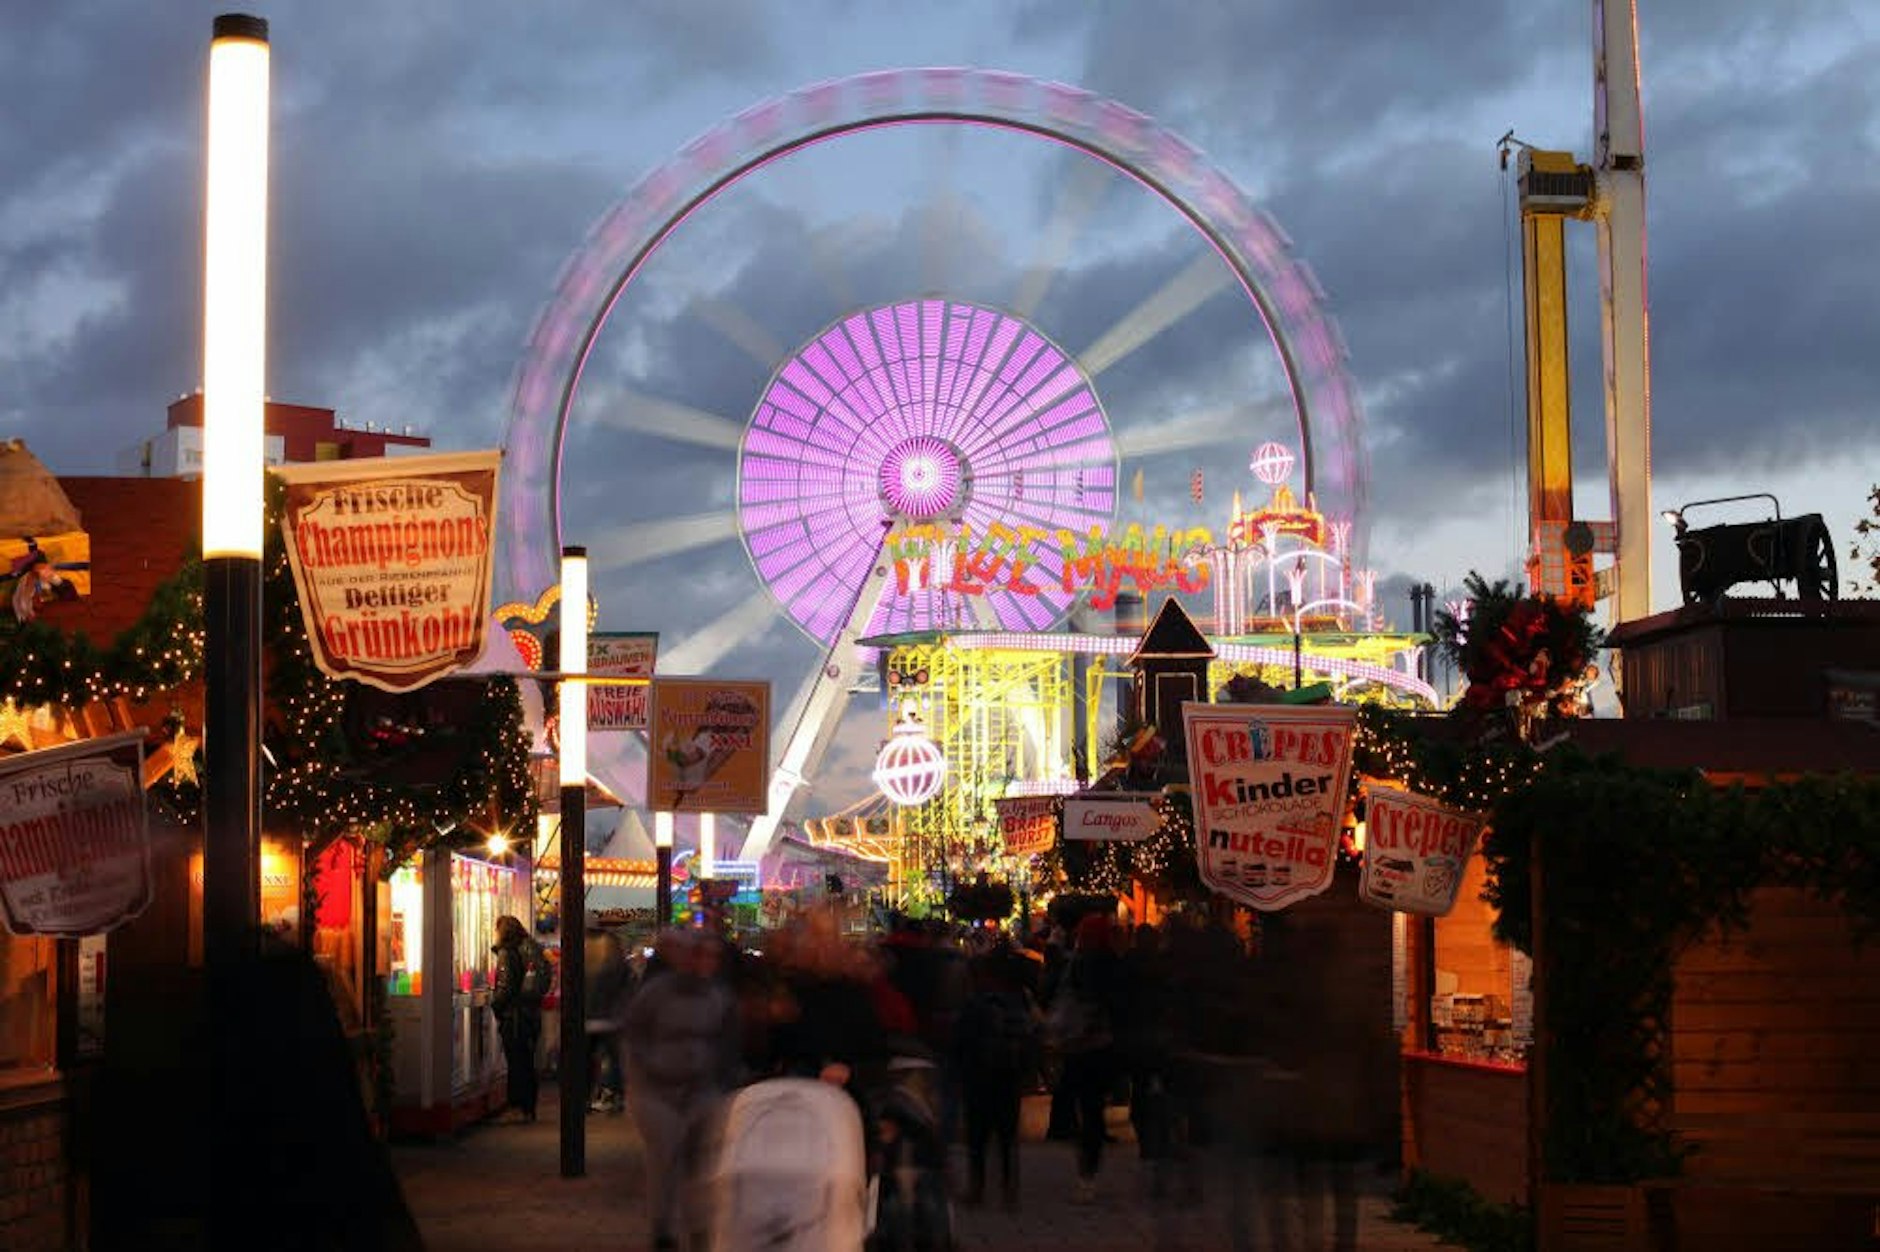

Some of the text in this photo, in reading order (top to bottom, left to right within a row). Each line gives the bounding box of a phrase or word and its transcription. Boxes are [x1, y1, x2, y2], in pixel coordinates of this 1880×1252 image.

[332, 484, 444, 516] Frische
[297, 513, 488, 569] Champignons
[324, 604, 472, 660] Grünkohl
[593, 686, 642, 698] FREIE
[12, 763, 94, 804] Frische
[1212, 797, 1324, 821] SCHOKOLADE
[1209, 828, 1327, 868] nutella
